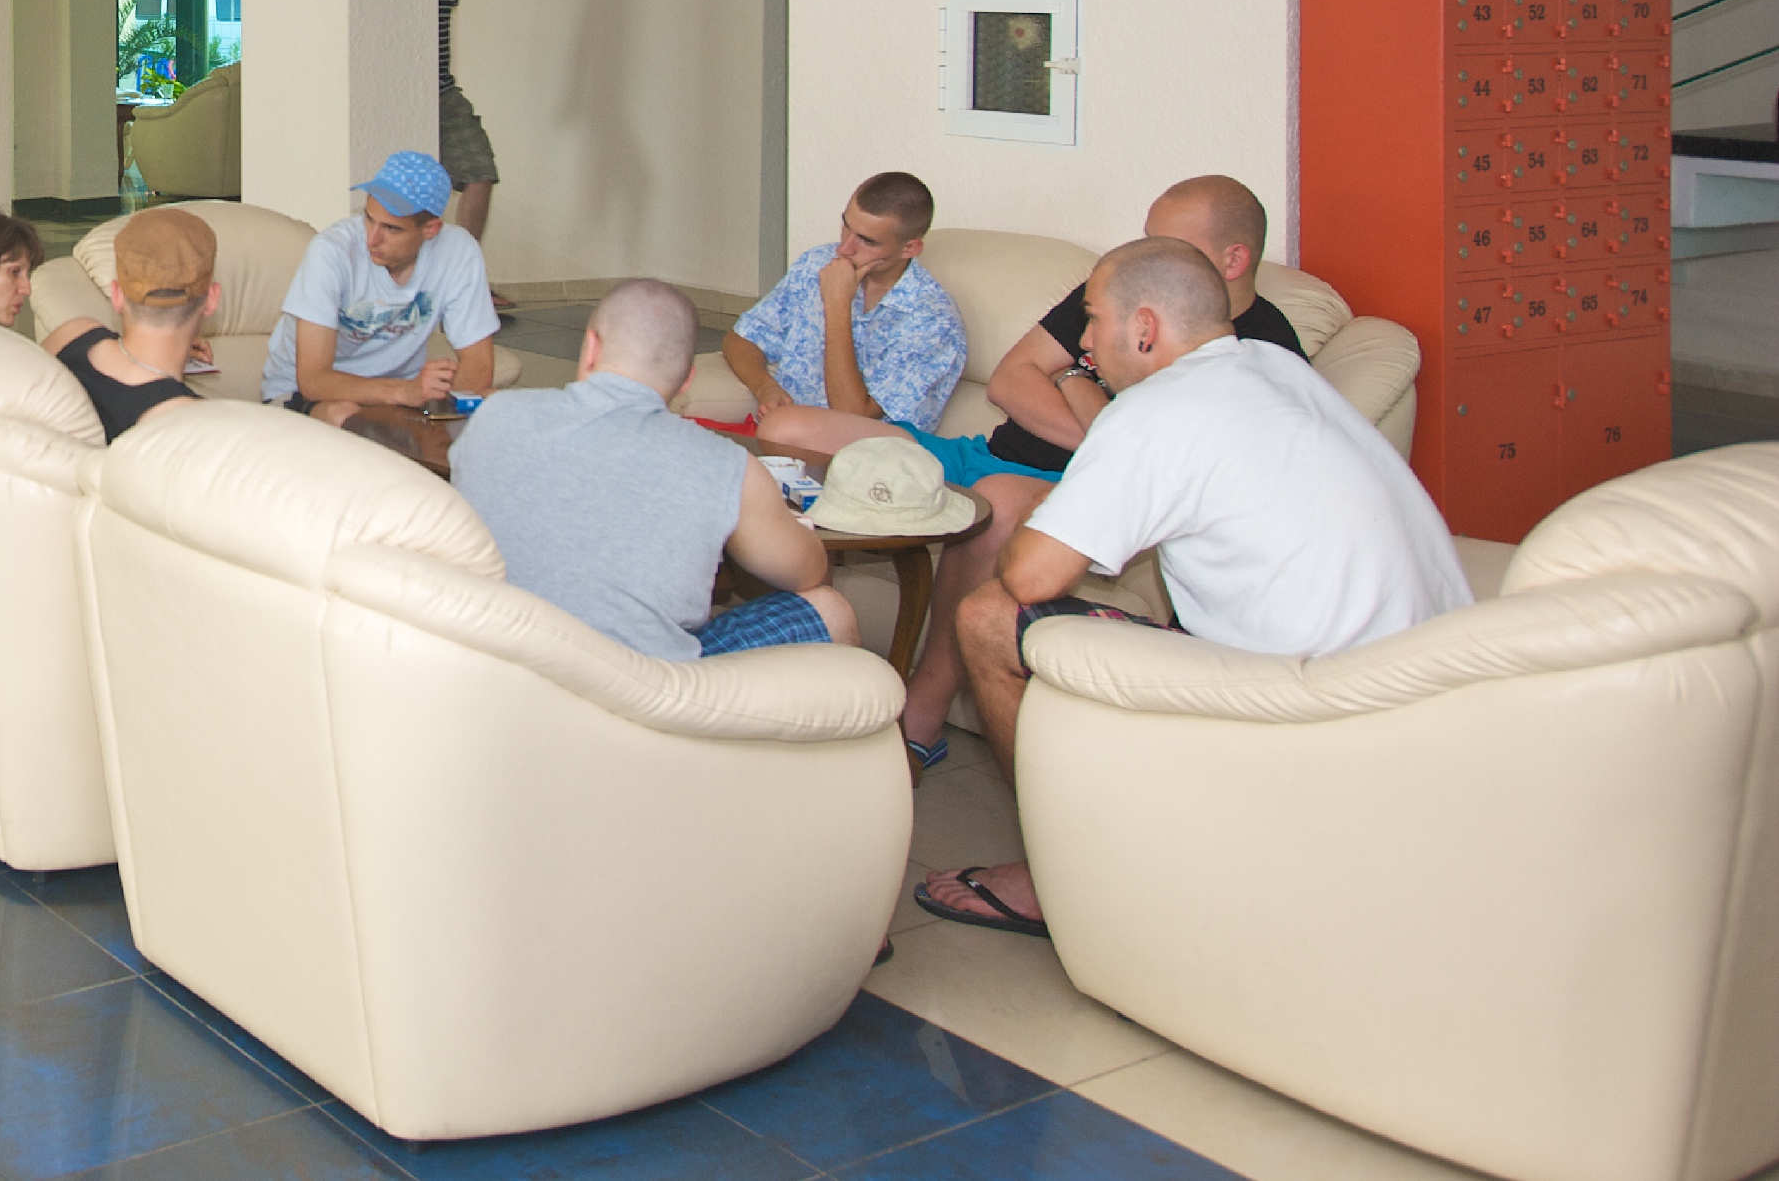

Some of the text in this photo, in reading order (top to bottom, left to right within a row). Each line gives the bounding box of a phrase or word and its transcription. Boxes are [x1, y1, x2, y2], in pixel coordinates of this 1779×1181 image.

[1473, 4, 1492, 22] 43
[1528, 3, 1546, 21] 52
[1581, 3, 1598, 21] 61
[1632, 2, 1650, 19] 70
[1473, 79, 1491, 97] 44
[1528, 77, 1546, 95] 53
[1581, 75, 1599, 93] 62
[1632, 73, 1648, 91] 71
[1528, 151, 1546, 169] 54
[1581, 148, 1600, 166] 63
[1632, 144, 1650, 161] 72
[1473, 153, 1492, 172] 45
[1528, 224, 1547, 243] 55
[1581, 221, 1599, 239] 64
[1632, 216, 1650, 234] 73
[1472, 229, 1492, 247] 46
[1580, 294, 1599, 312] 65
[1631, 289, 1648, 306] 74
[1473, 306, 1492, 324] 47
[1528, 300, 1547, 318] 56
[1604, 425, 1622, 444] 76
[1498, 442, 1517, 460] 75
